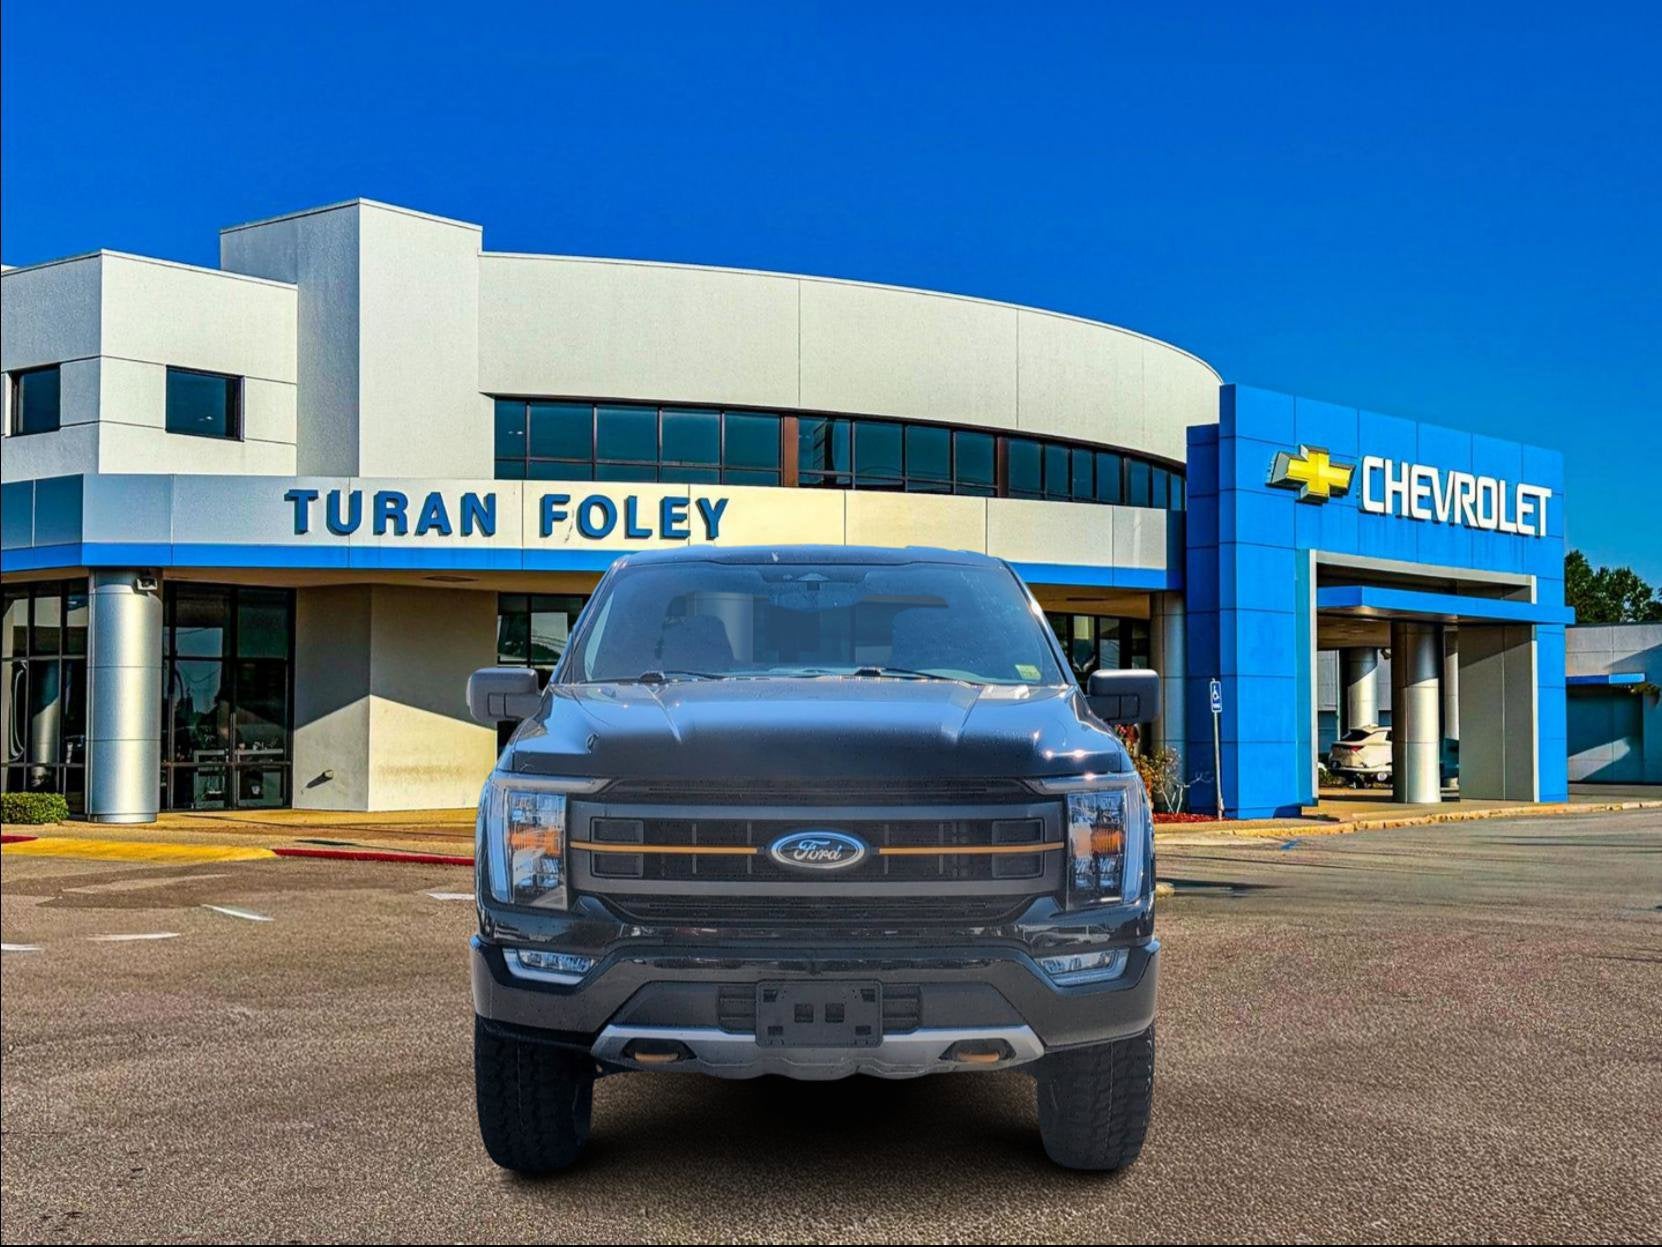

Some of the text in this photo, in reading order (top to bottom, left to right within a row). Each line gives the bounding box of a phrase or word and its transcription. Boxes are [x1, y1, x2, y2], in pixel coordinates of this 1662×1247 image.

[284, 488, 729, 540] TURAN FOLEY
[1361, 455, 1552, 537] CHEVROLET
[793, 839, 842, 861] Ford
